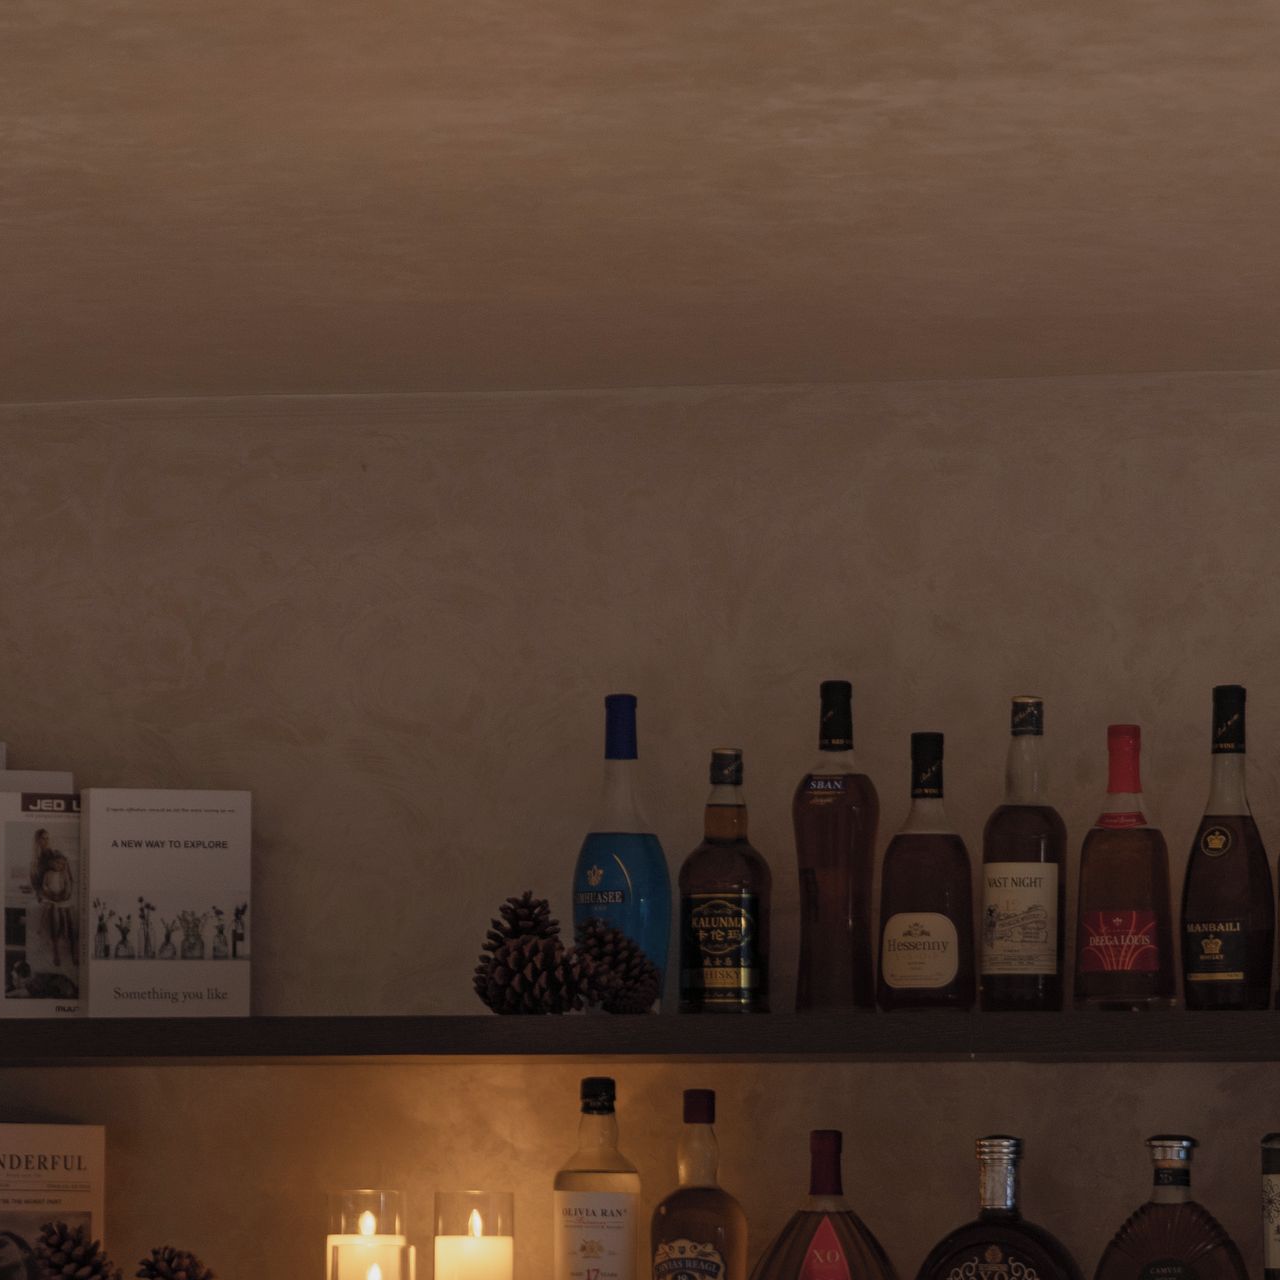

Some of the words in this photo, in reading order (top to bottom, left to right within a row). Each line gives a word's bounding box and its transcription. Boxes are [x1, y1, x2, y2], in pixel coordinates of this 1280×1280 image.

[810, 781, 843, 789] SBAN
[28, 799, 65, 811] JED
[111, 840, 119, 848] A
[121, 840, 143, 848] NEW
[145, 840, 165, 849] WAY
[169, 840, 181, 849] TO
[183, 840, 228, 849] EXPLORE
[988, 876, 1008, 888] VAST
[1011, 876, 1044, 889] NIGHT
[887, 938, 949, 953] Hessenny
[1089, 934, 1119, 947] DEEGA
[1121, 933, 1151, 946] LOUIS
[113, 987, 179, 1003] Something
[181, 990, 203, 1003] you
[207, 987, 228, 1000] like
[562, 1207, 597, 1217] OLIVIA
[812, 1249, 840, 1263] XO
[585, 1268, 600, 1280] 17
